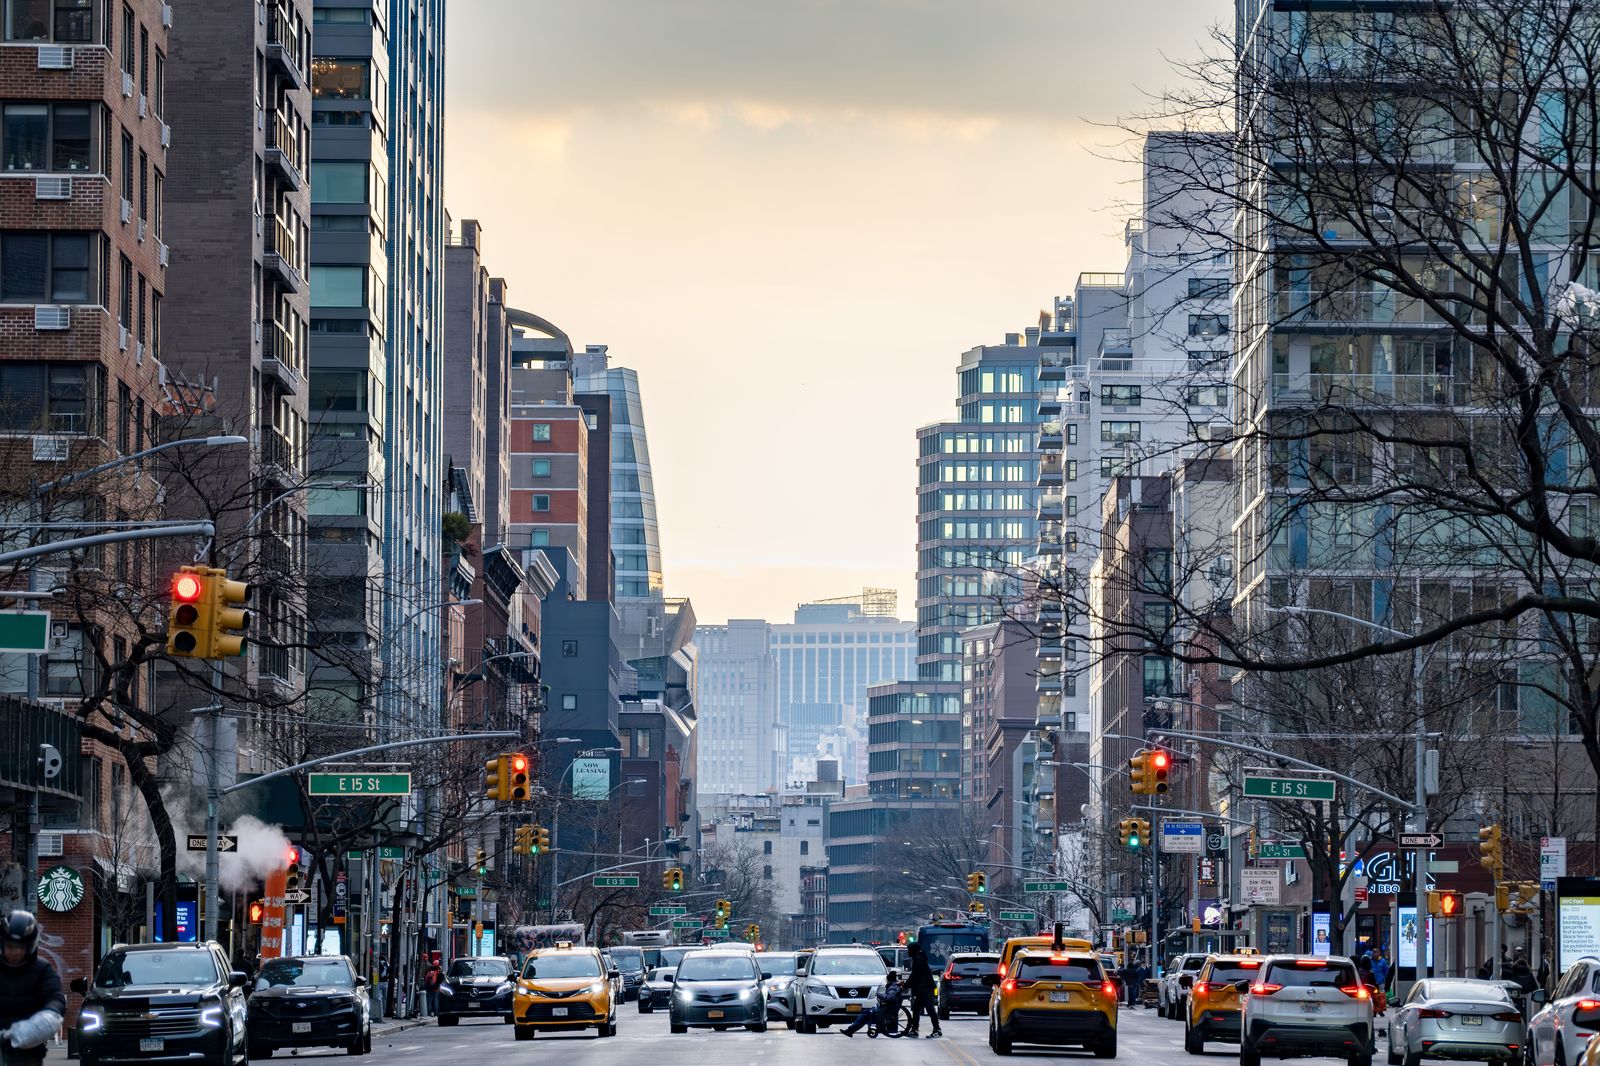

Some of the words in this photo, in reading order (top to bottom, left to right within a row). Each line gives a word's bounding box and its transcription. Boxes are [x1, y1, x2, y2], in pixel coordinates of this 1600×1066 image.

[340, 778, 346, 790] E
[352, 778, 362, 790] 15
[368, 778, 380, 790] St
[1271, 782, 1277, 793] E
[1282, 783, 1291, 794] 15
[1296, 784, 1307, 795] St
[1379, 884, 1400, 893] BBQ
